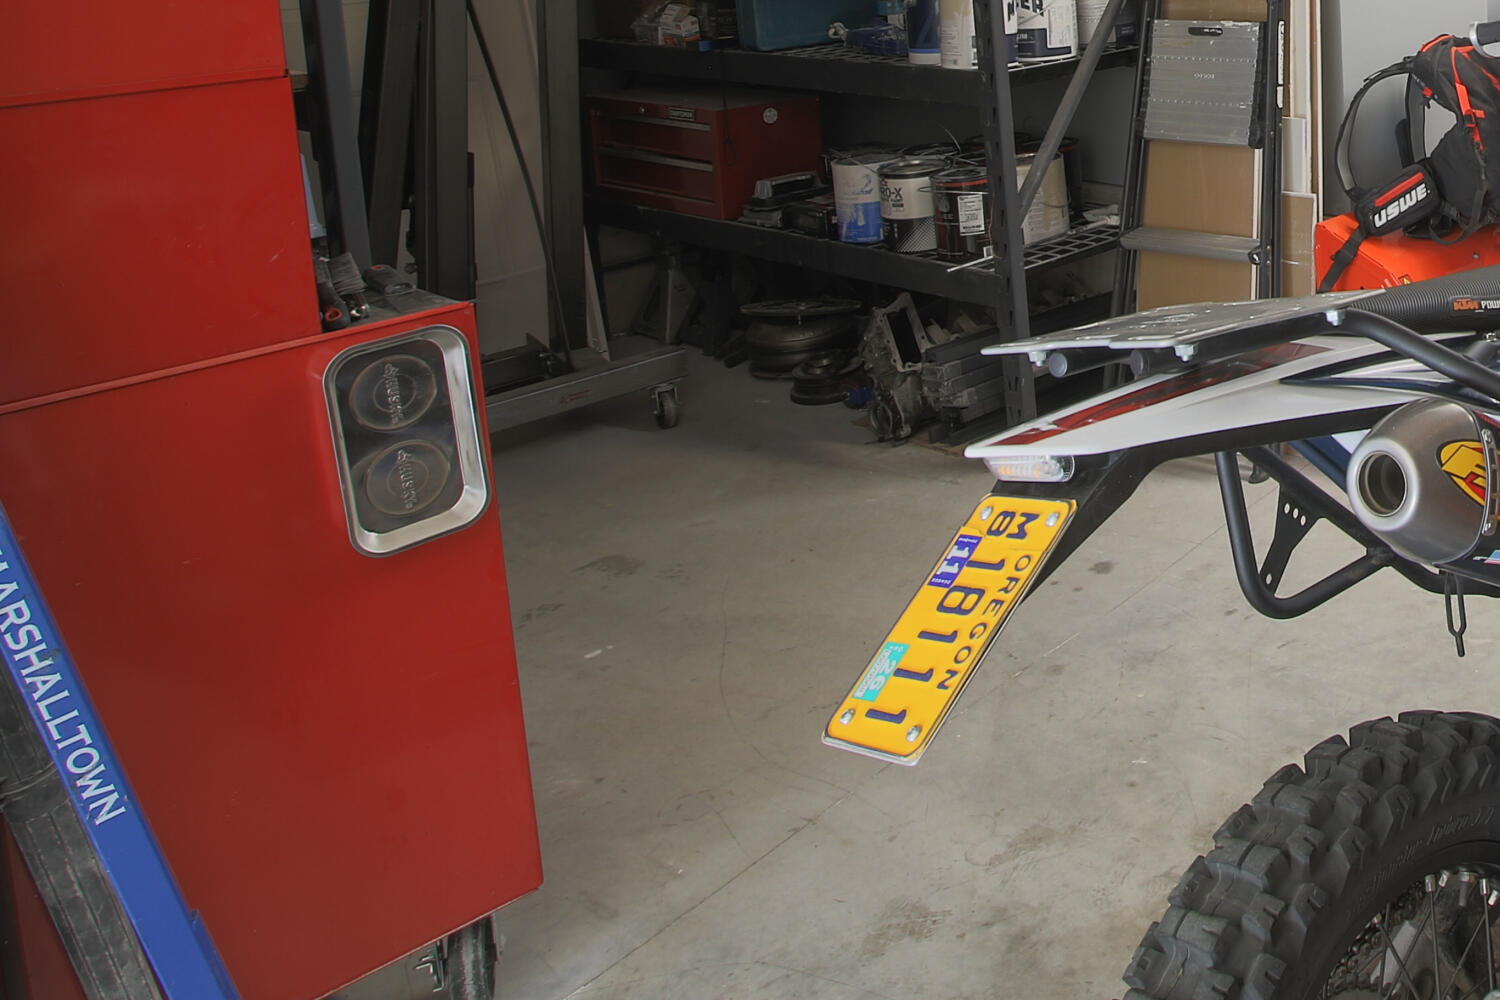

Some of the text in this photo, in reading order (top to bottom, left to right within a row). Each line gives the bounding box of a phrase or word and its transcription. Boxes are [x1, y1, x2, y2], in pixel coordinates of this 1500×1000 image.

[1374, 183, 1428, 228] USWE
[1453, 298, 1480, 311] KTM
[936, 554, 1032, 691] OREGON
